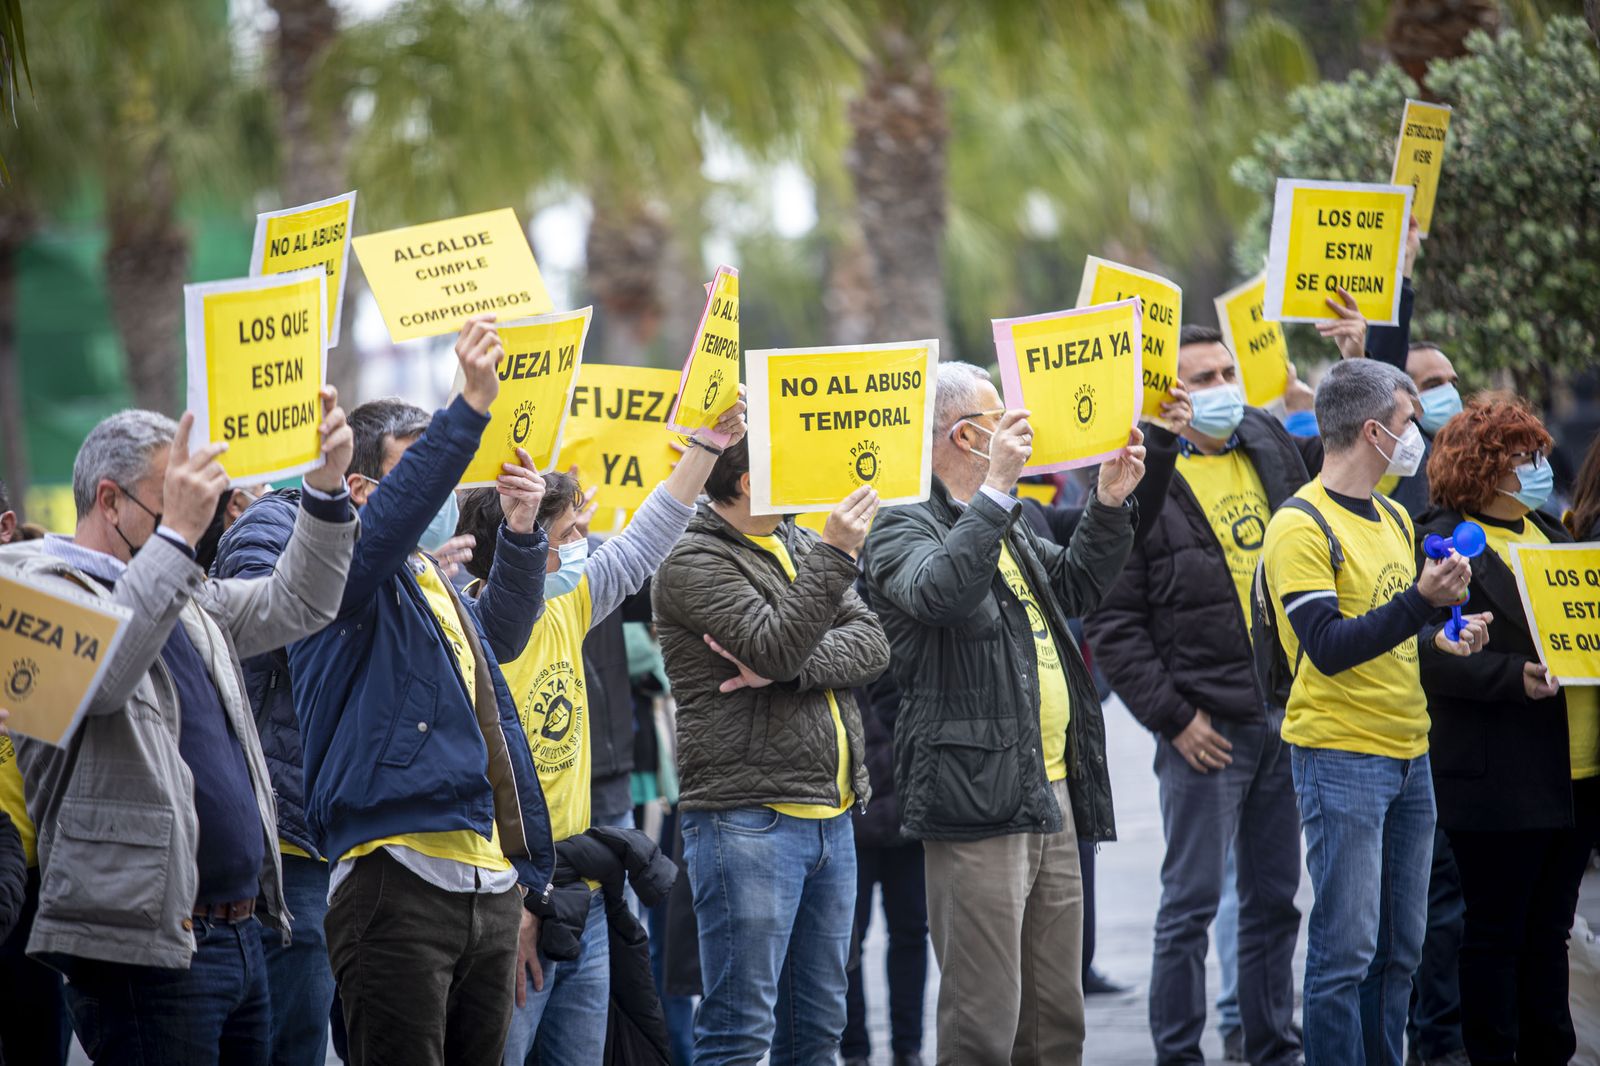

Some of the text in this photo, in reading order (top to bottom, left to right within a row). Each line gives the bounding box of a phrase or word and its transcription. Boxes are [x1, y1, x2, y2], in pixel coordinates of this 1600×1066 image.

[1318, 209, 1384, 229] LOS QUE
[270, 222, 345, 257] NO AL ABUSO
[394, 231, 493, 263] ALCALDE
[1325, 242, 1372, 261] ESTAN
[415, 256, 489, 281] CUMPLE
[441, 280, 478, 296] TUS
[1295, 273, 1383, 293] SE QUEDAN
[399, 291, 532, 327] COMPROMISOS
[720, 300, 734, 321] AL
[1149, 302, 1173, 326] QUE
[239, 309, 309, 344] LOS QUE
[701, 332, 739, 361] TEMPOR
[1026, 331, 1131, 373] FIJEZA YA
[1142, 333, 1164, 357] TAN
[252, 357, 303, 390] ESTAN
[495, 344, 575, 381] JEZA YA
[781, 370, 921, 397] NO AL ABUSO
[1074, 384, 1095, 401] PATAC
[1142, 369, 1173, 393] DAN
[223, 400, 315, 440] SE QUEDAN
[514, 400, 535, 418] PATAC
[799, 407, 910, 431] TEMPORAL
[850, 440, 880, 457] PATAC
[602, 453, 643, 487] YA
[1545, 569, 1580, 587] LOS
[1562, 601, 1600, 618] EST
[0, 603, 99, 662] JEZA YA
[1549, 633, 1572, 650] SE
